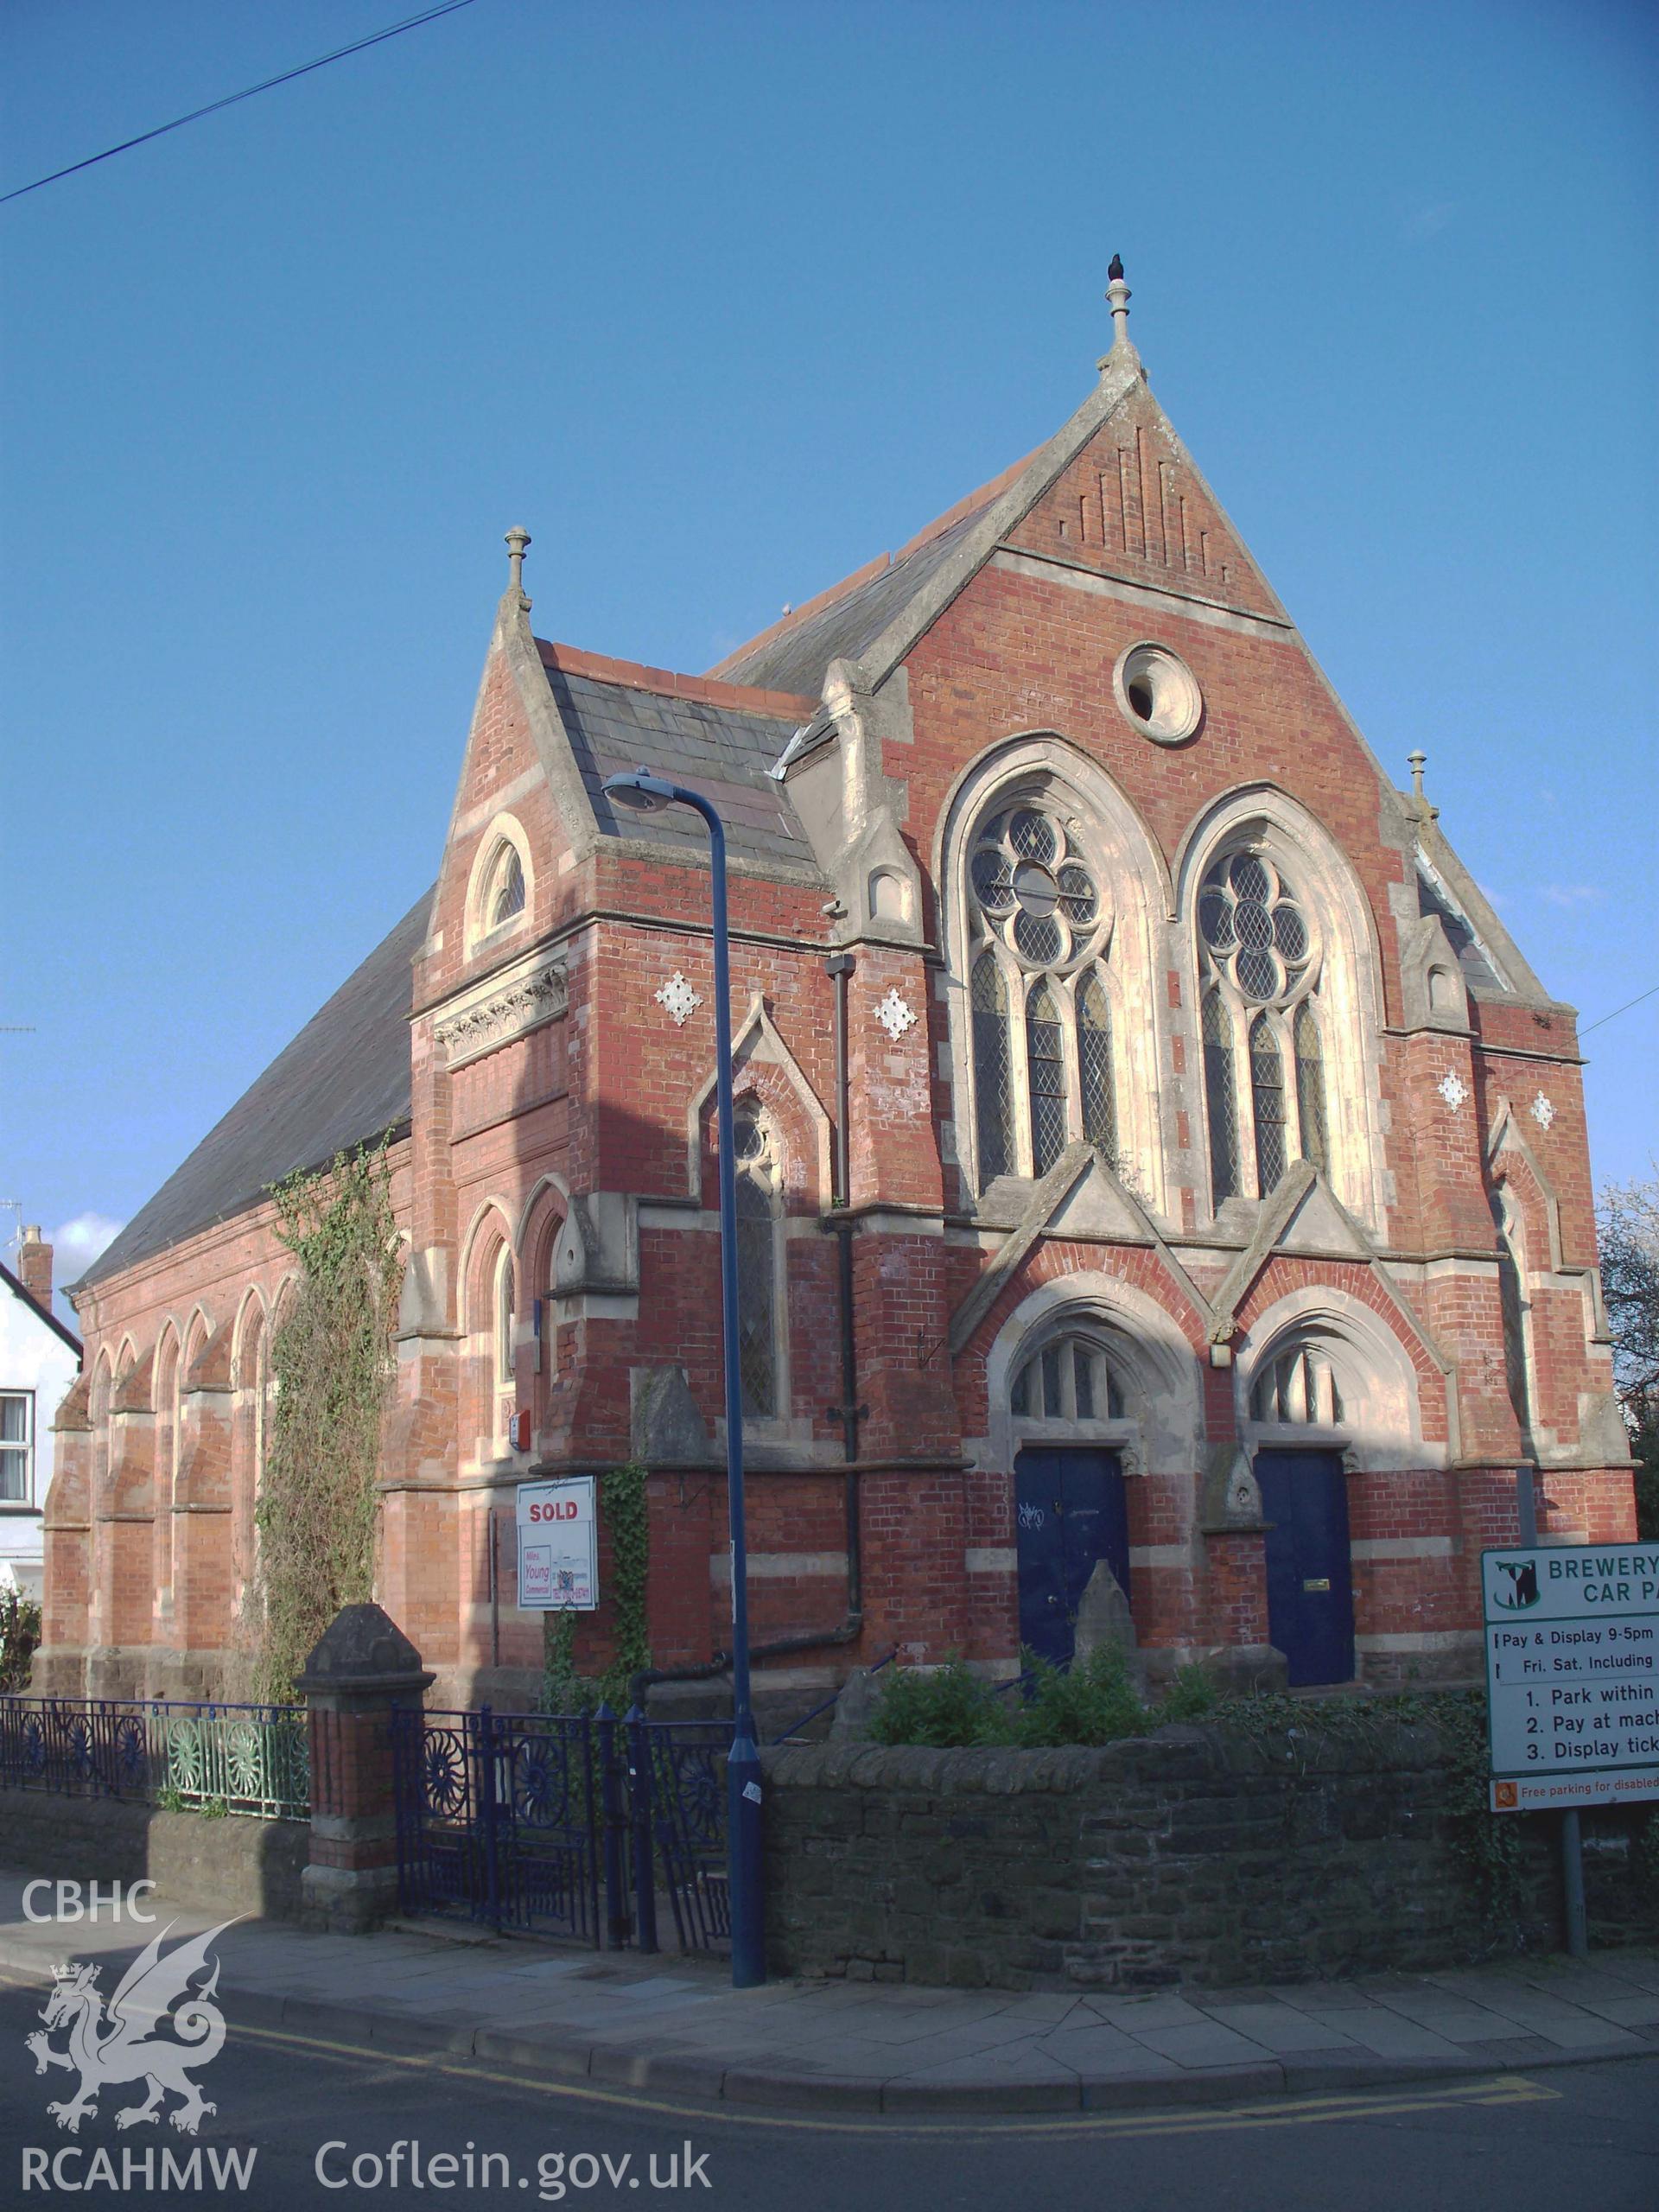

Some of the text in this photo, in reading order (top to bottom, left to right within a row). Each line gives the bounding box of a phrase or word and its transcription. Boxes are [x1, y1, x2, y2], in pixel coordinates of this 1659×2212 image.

[530, 1501, 578, 1522] SOLD
[525, 1565, 550, 1582] Young
[1548, 1556, 1659, 1580] BREWERY
[1584, 1581, 1630, 1603] CAR
[1503, 1632, 1527, 1649] Pay
[1535, 1632, 1544, 1645] &
[1551, 1627, 1602, 1645] Display
[1608, 1626, 1653, 1643] 9-5pm
[1523, 1654, 1653, 1674] Fri. Sat. Including
[1526, 1686, 1654, 1707] 1. Park within
[1526, 1717, 1544, 1734] 2.
[1554, 1714, 1585, 1733] Pay
[1593, 1713, 1611, 1729] at
[1527, 1744, 1545, 1760] 3.
[1554, 1739, 1619, 1759] Display
[1522, 1777, 1659, 1798] Free parking for disabled
